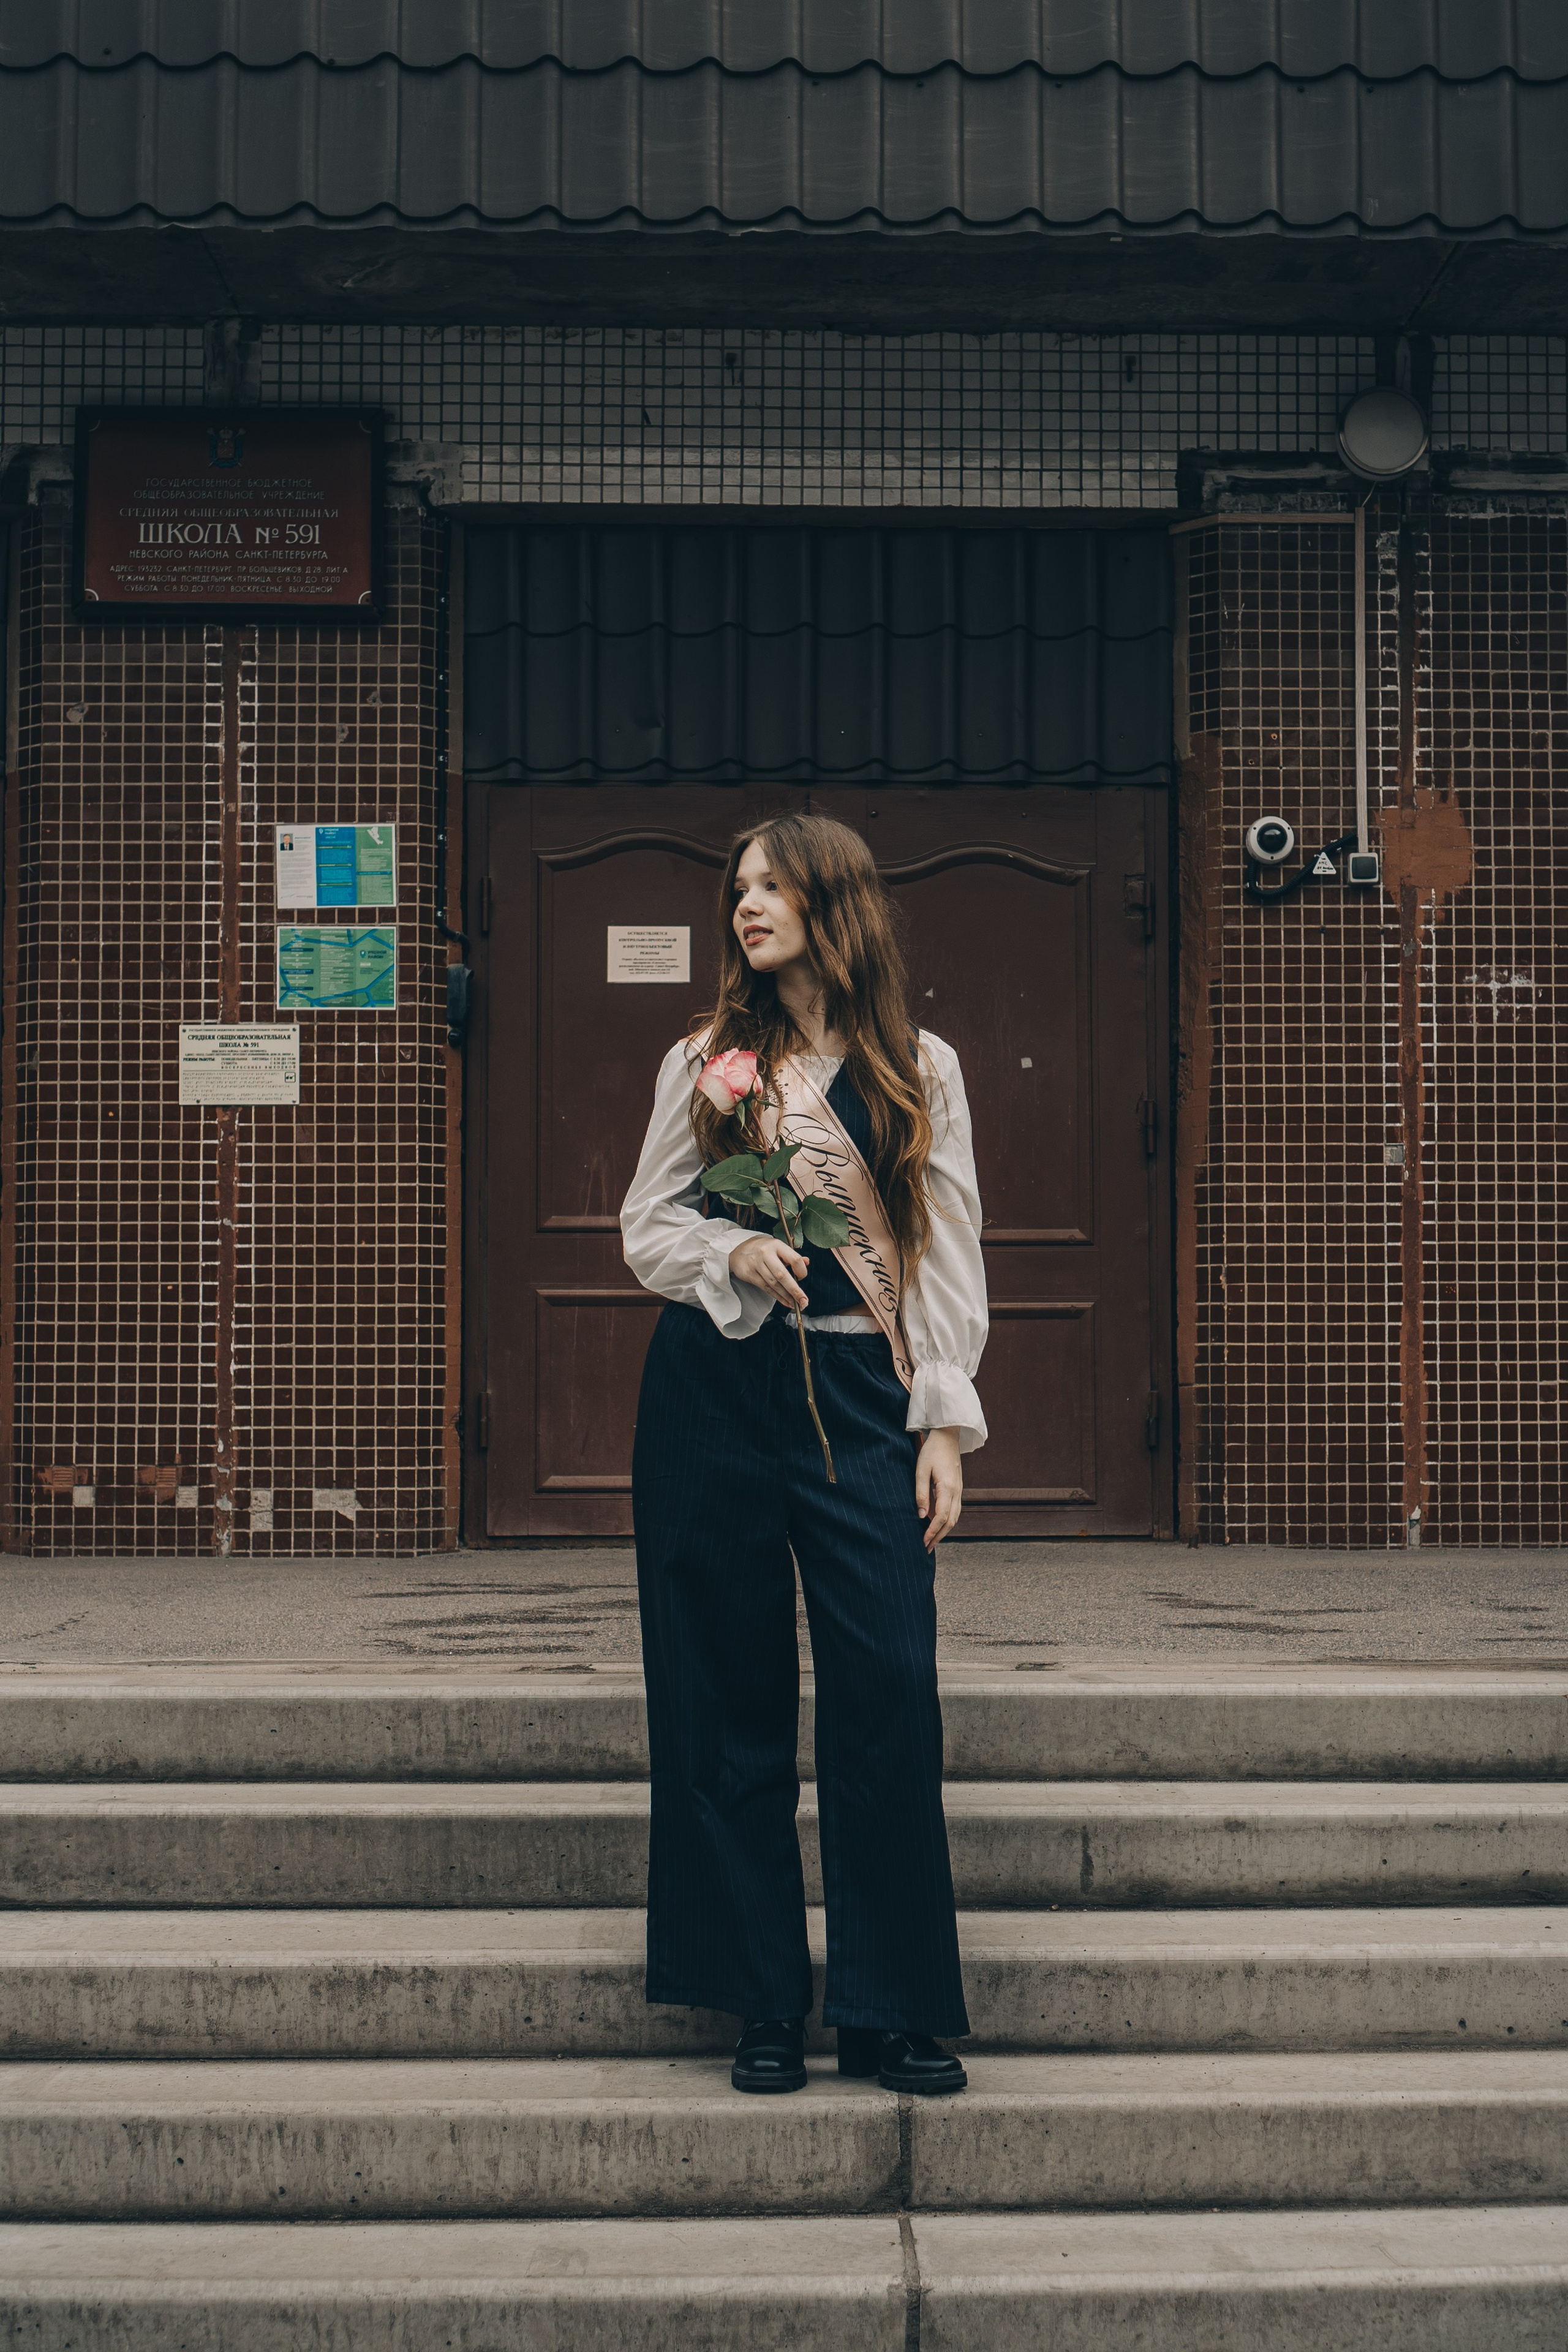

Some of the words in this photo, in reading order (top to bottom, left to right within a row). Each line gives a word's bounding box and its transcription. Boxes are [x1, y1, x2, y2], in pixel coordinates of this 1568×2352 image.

[145, 478, 242, 488] ГОСУДАРСТВЕННОЕ
[247, 478, 313, 488] БЮДЖЕТНОЕ
[134, 489, 254, 500] ОБЩЕОБРАЗОВАТЕЛЬНОЕ
[262, 490, 325, 500] УЧРЕЖДЕНИЕ
[119, 508, 178, 518] СРЕДНЯЯ
[184, 508, 339, 518] ОБЩЕОБРАЗОВАТЕЛЬНАЯ
[138, 522, 244, 544] ШКОЛА
[255, 526, 279, 544] №
[284, 524, 321, 545] 591
[129, 549, 183, 559] НЕВСКОГО
[189, 548, 229, 559] РАЙОНА
[235, 549, 328, 560] САНКТ-ПЕТЕРБУРГА
[288, 584, 333, 594] ВЫХОДНОЙ
[776, 1114, 899, 1313] Выпускниц
